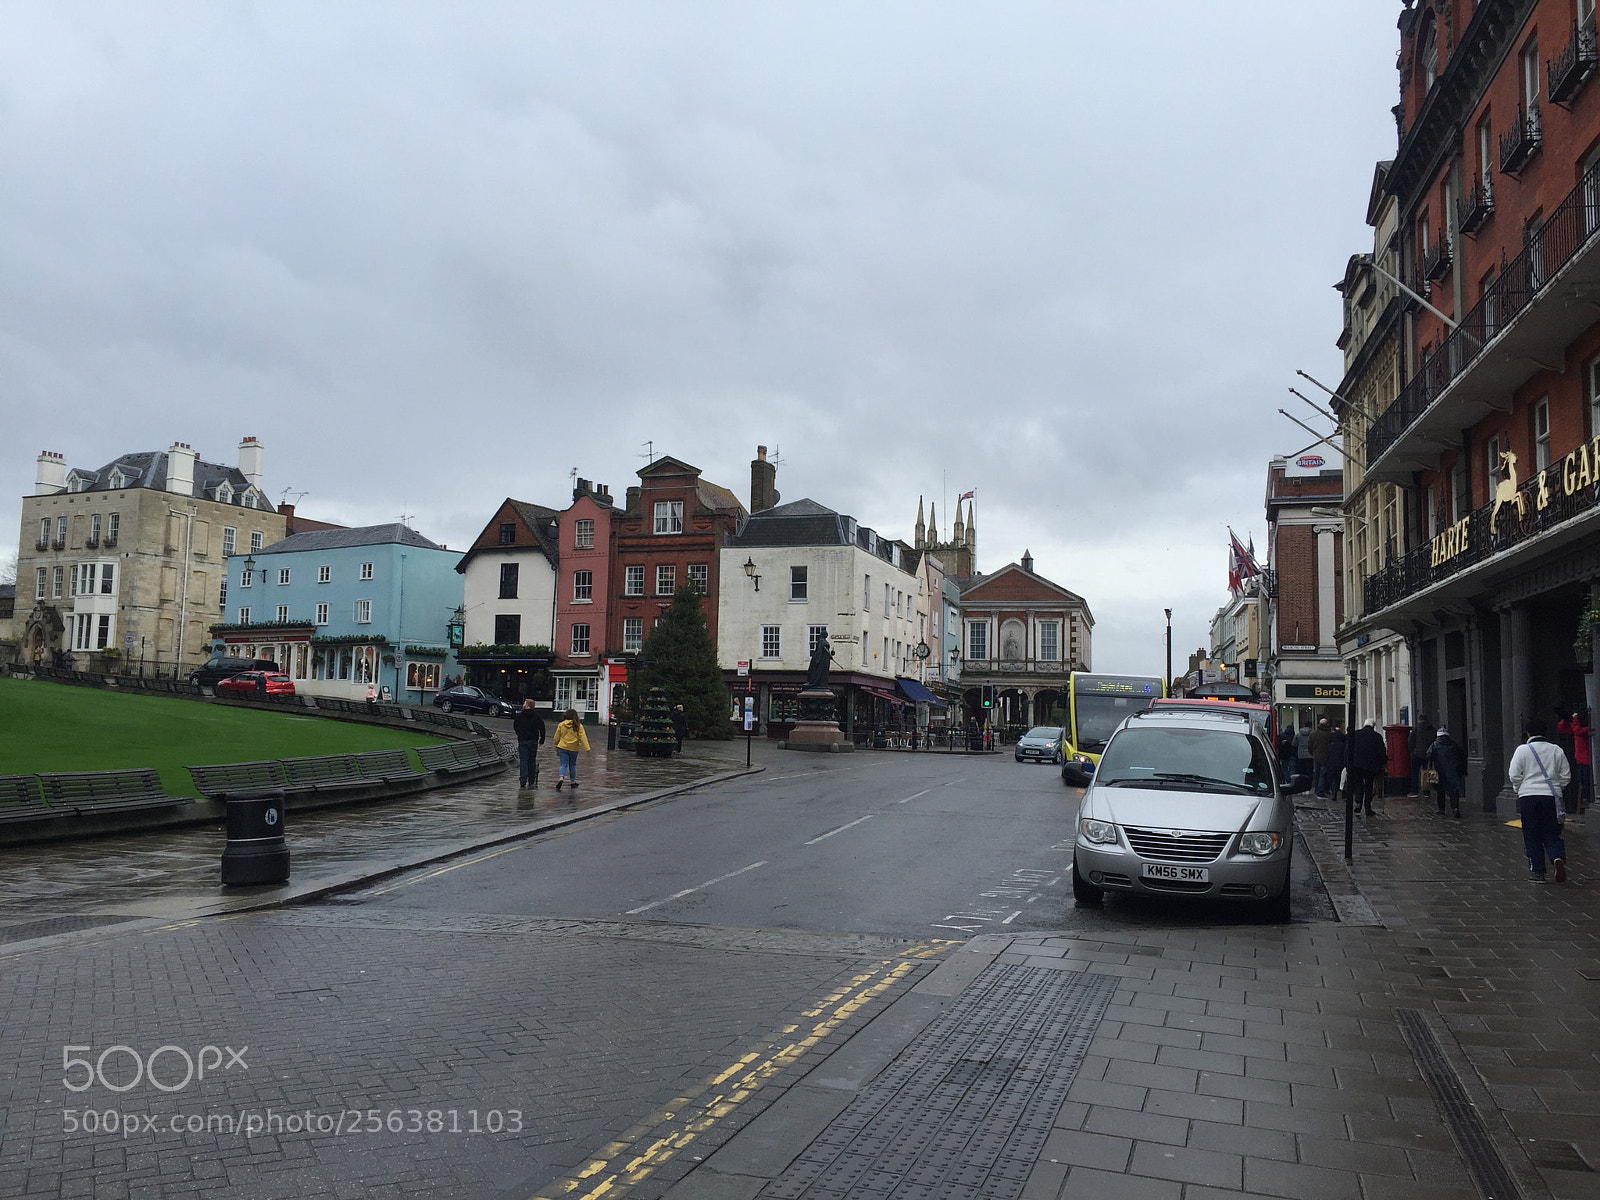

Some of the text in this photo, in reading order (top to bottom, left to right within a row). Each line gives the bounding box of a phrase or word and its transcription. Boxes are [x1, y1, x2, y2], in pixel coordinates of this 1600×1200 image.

[1431, 516, 1470, 567] HARTE
[1537, 470, 1549, 511] &
[1148, 865, 1203, 880] KM56 SMX
